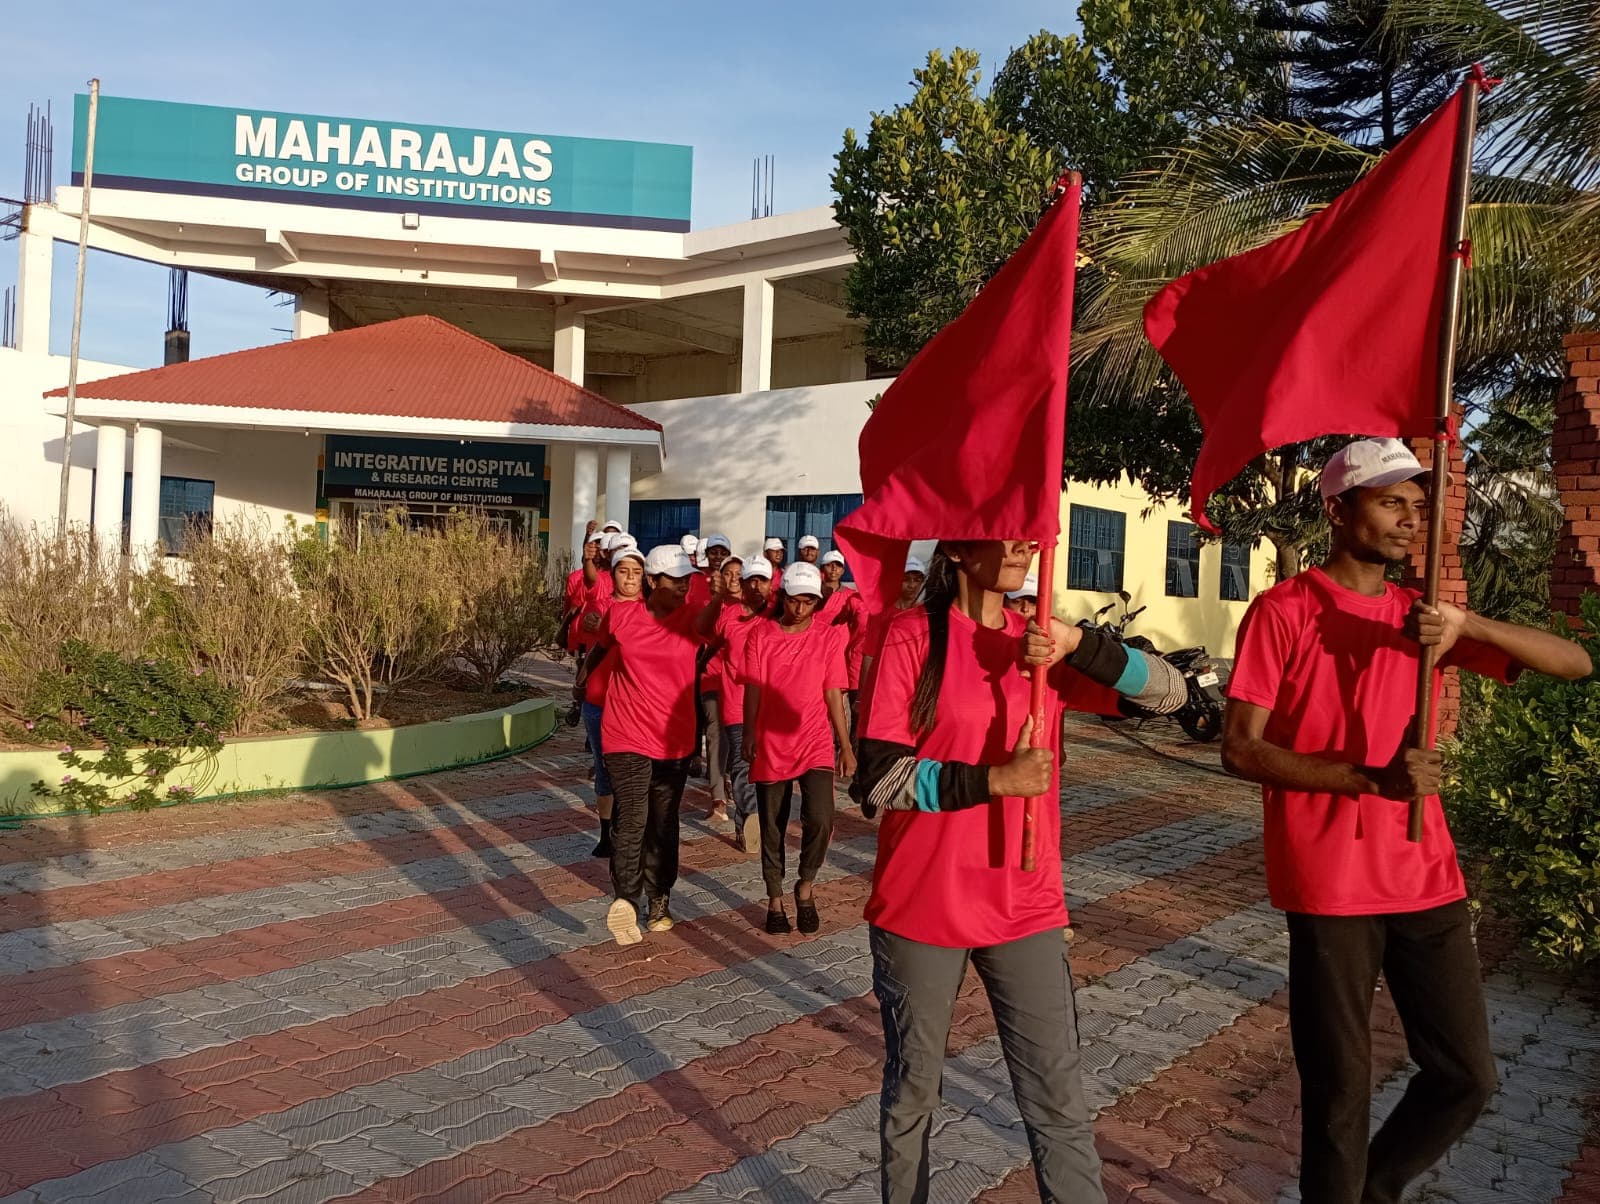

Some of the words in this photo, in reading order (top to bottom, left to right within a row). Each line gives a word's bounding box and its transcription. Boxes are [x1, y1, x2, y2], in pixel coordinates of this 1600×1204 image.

[235, 114, 553, 182] MAHARAJAS
[235, 163, 328, 188] GROUP
[335, 172, 369, 191] OF
[377, 175, 552, 206] INSTITUTIONS
[334, 452, 448, 472] INTEGRATIVE
[453, 458, 534, 477] HOSPITAL
[371, 472, 380, 482] &
[383, 472, 448, 486] RESEARCH
[451, 476, 499, 488] CENTRE
[354, 488, 407, 499] MAHARAJAS
[408, 491, 438, 500] GROUP
[440, 493, 452, 501] OF
[453, 493, 513, 504] INSTITUTIONS
